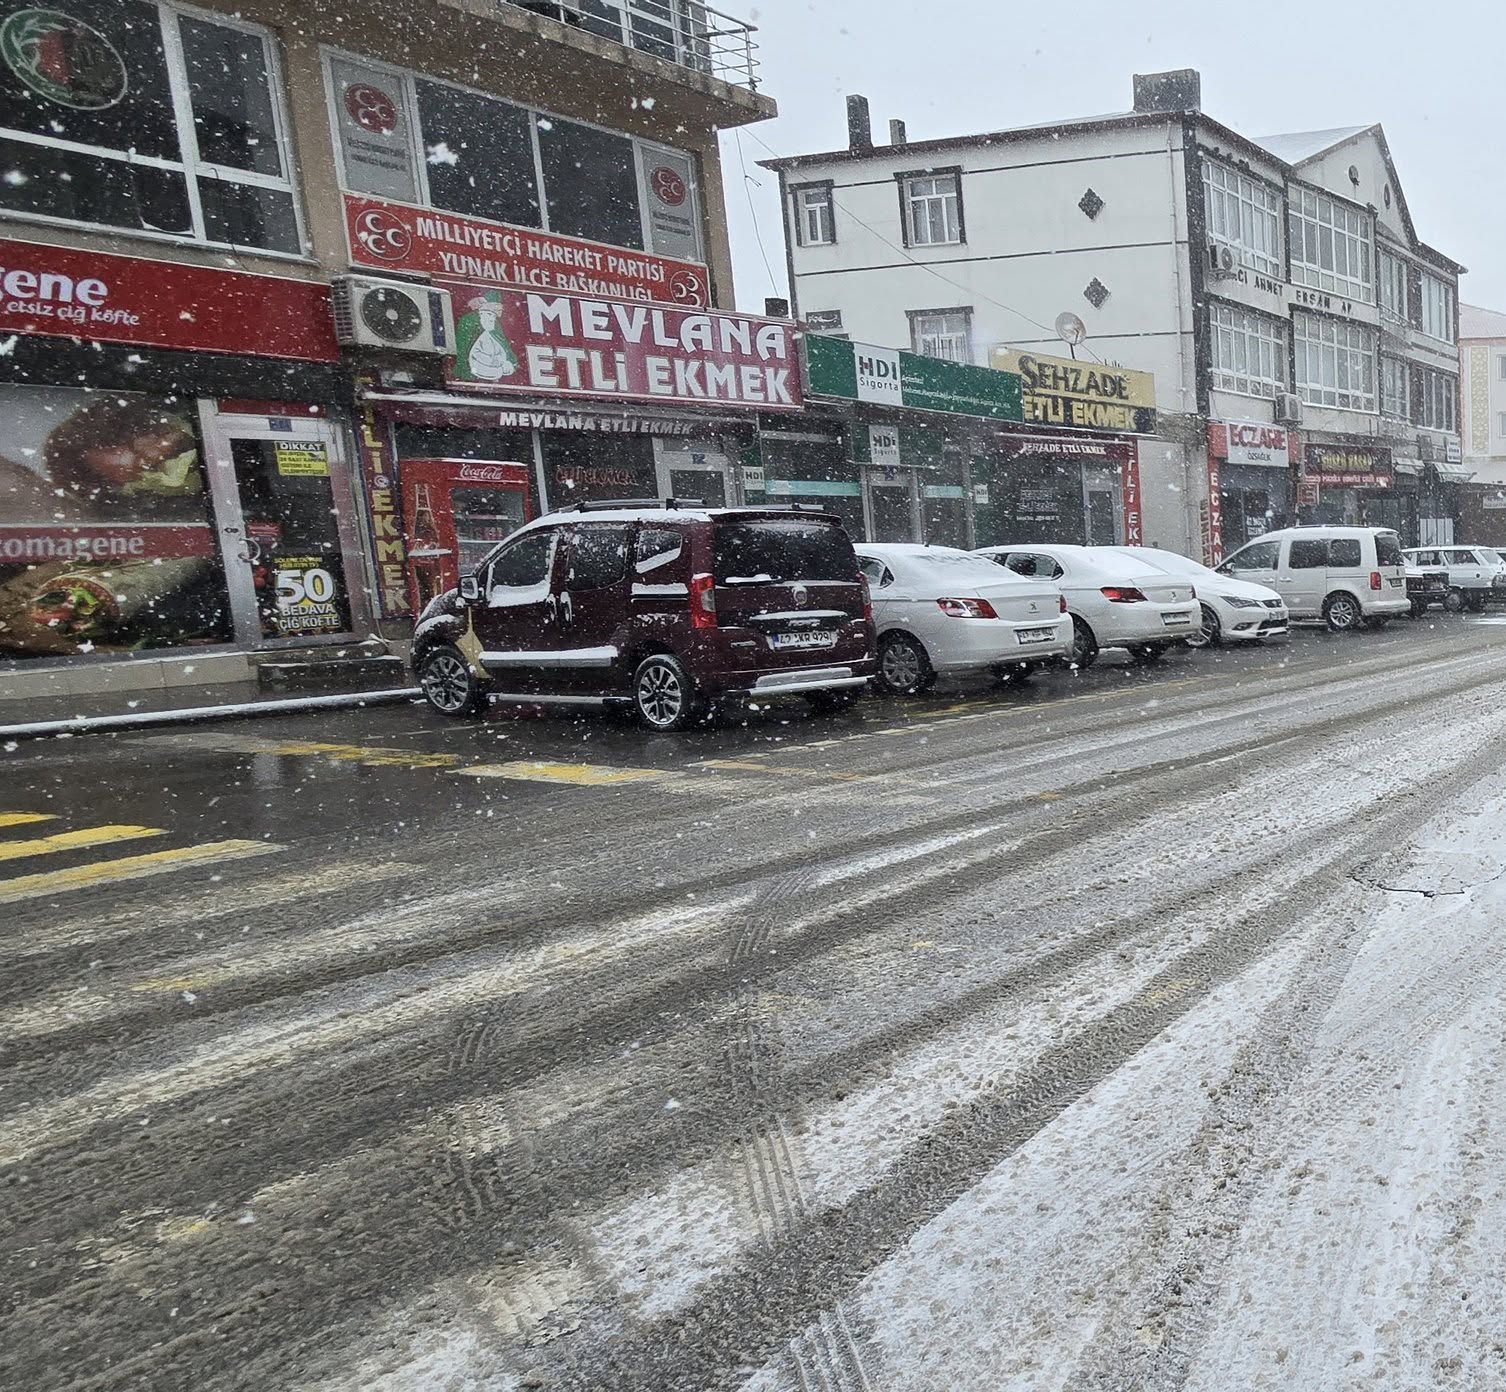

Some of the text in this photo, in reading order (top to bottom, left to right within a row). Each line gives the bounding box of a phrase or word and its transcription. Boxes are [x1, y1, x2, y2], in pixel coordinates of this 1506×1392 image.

[416, 215, 665, 283] MİLLİYETÇİ HAREKET PARTİSİ
[438, 251, 508, 282] YUNAK
[0, 266, 108, 306] ene
[57, 305, 86, 323] çiğ
[91, 308, 140, 325] köfte
[526, 294, 786, 361] MEVLANA
[525, 345, 793, 403] ETLİ EKMEK
[859, 356, 898, 380] HDI
[860, 377, 899, 391] Sigorta
[500, 411, 595, 430] MEVLANA
[641, 420, 692, 435] EKMEK
[1072, 401, 1137, 430] EKMEK
[1229, 424, 1286, 450] ECZANE
[460, 464, 503, 480] Coca-Cola
[0, 535, 144, 562] omagene
[372, 489, 410, 611] EKMEK
[281, 603, 336, 616] BEDAVA
